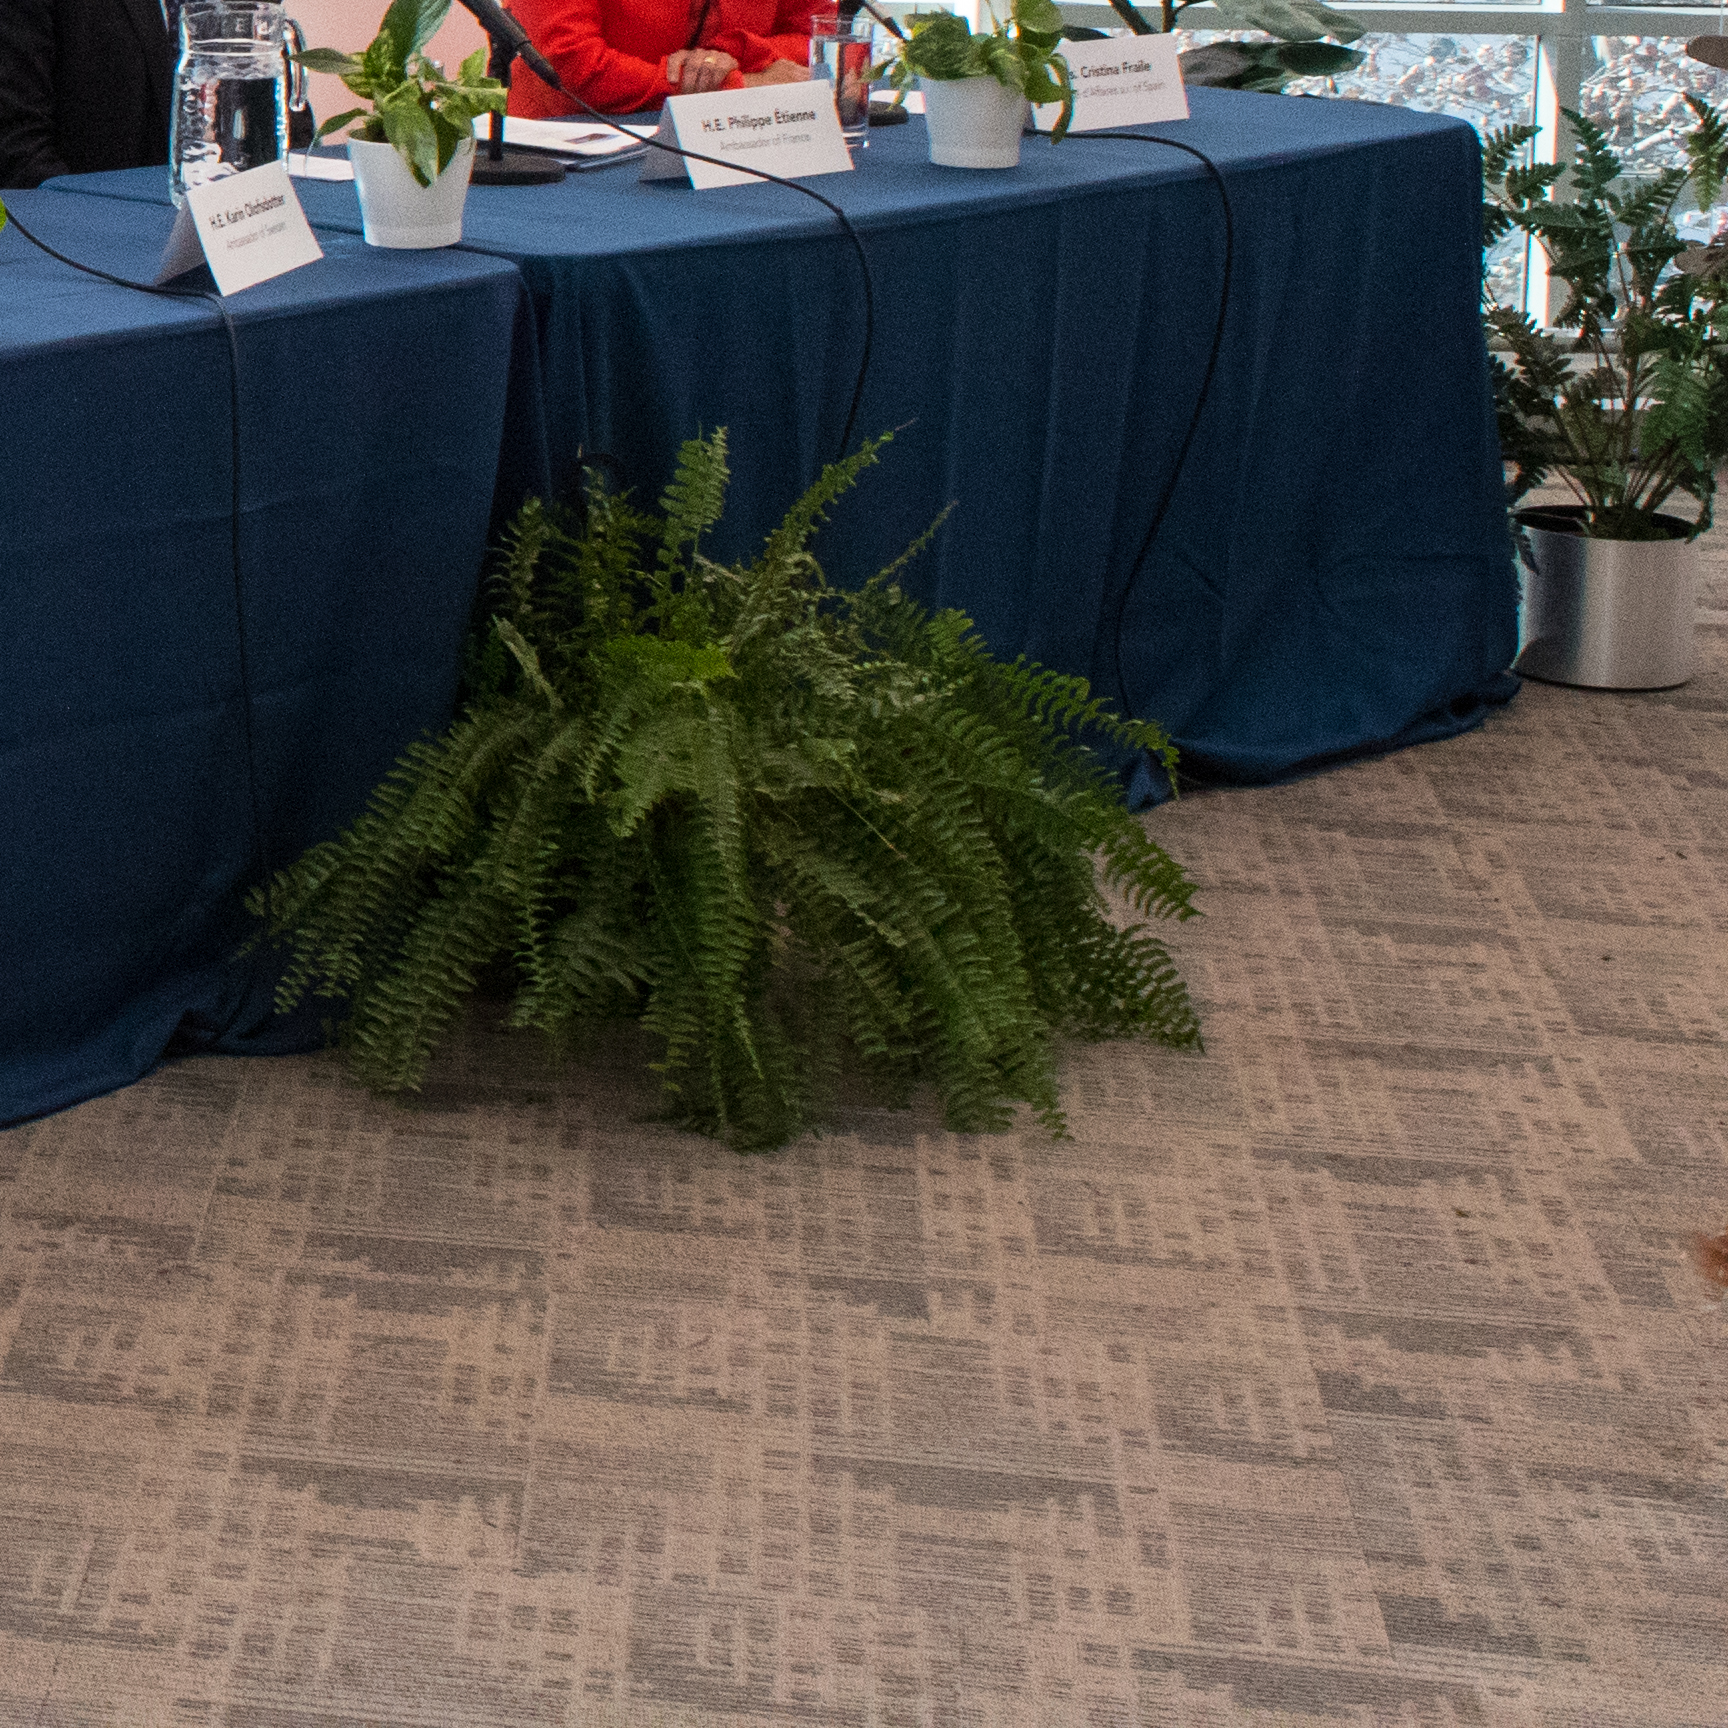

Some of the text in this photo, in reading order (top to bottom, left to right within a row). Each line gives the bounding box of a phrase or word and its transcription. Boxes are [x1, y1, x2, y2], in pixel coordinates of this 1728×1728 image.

[1080, 64, 1120, 78] Cristina
[1122, 60, 1150, 73] Fraile
[702, 108, 816, 132] H.E. Philippe Étienne
[720, 132, 811, 151] Ambassador of France
[209, 214, 225, 230] H.E.
